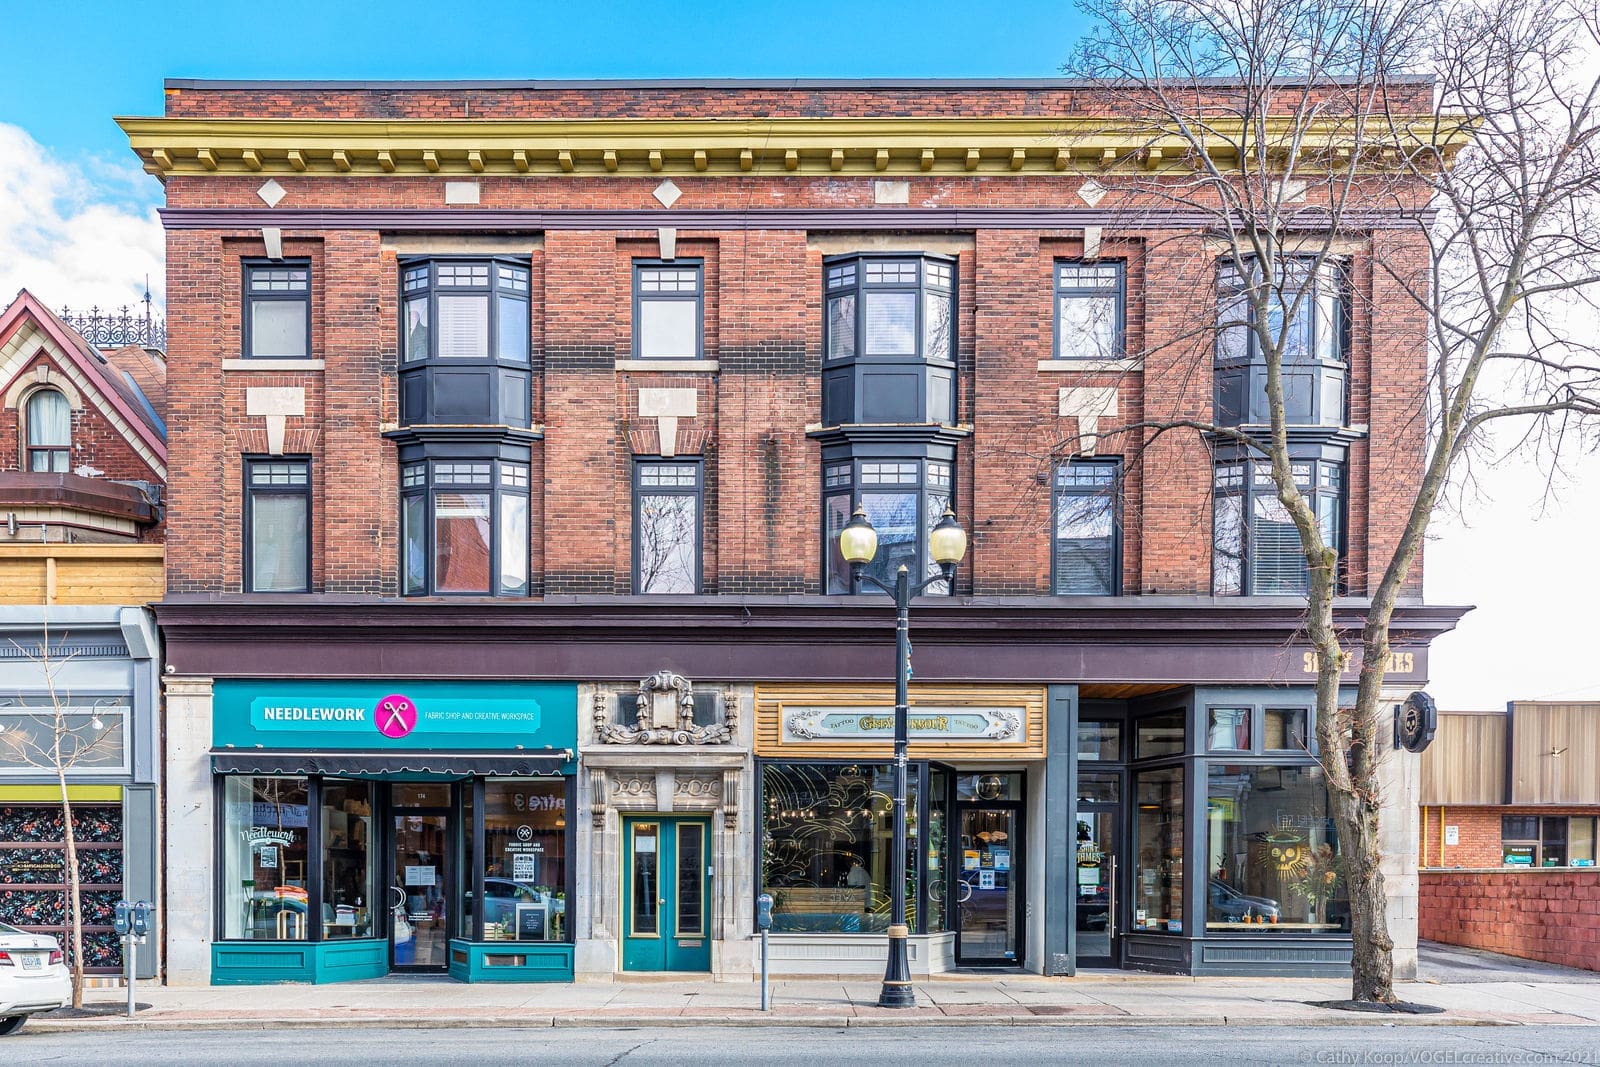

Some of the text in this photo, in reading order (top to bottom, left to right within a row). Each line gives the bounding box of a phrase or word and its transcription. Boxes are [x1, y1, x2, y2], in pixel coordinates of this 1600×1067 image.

[264, 707, 365, 720] NEEDLEWORK
[424, 711, 534, 720] FABRIC SHOP AND CREATIVE WORKSPACE
[830, 718, 854, 729] TATTOO
[954, 719, 979, 730] TATTOO
[240, 826, 294, 843] Needlework
[1077, 852, 1101, 863] JAMES
